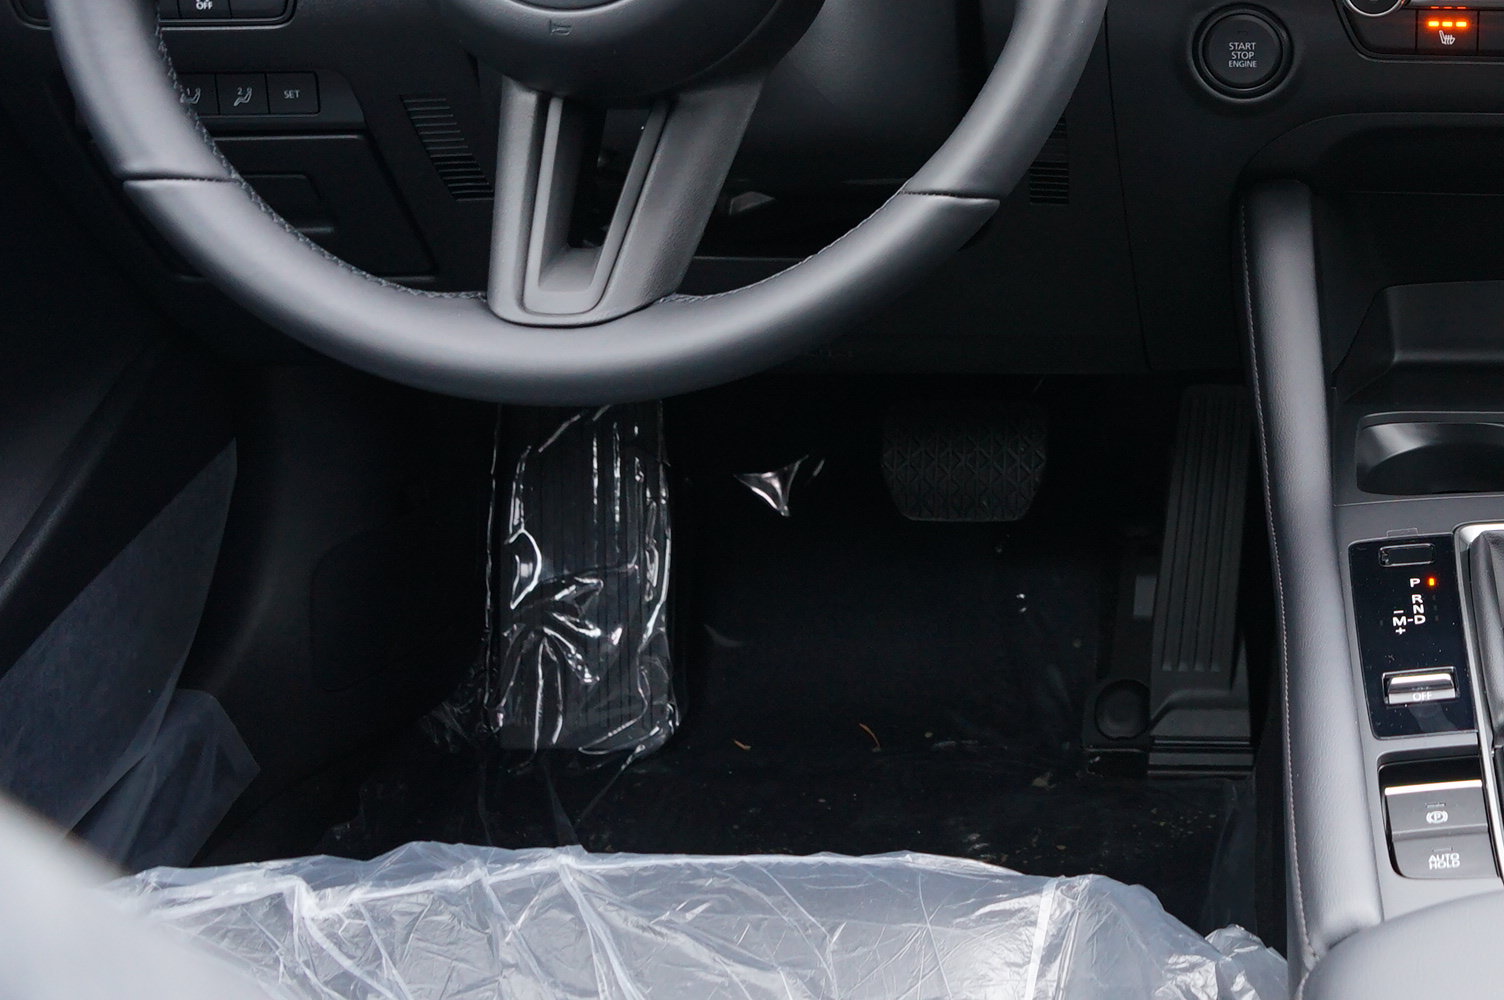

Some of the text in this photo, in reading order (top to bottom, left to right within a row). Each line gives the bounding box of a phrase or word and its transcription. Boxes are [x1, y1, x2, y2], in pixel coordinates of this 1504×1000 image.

[196, 2, 213, 10] OFF
[1228, 42, 1256, 50] START
[1231, 51, 1255, 59] STOP
[1228, 60, 1257, 68] ENGINE
[283, 90, 300, 99] SET
[1409, 578, 1420, 587] P
[1411, 594, 1423, 604] R
[1413, 604, 1424, 614] N
[1412, 692, 1432, 701] OFF
[1428, 853, 1460, 863] AUTO
[1428, 860, 1460, 870] HOLD
